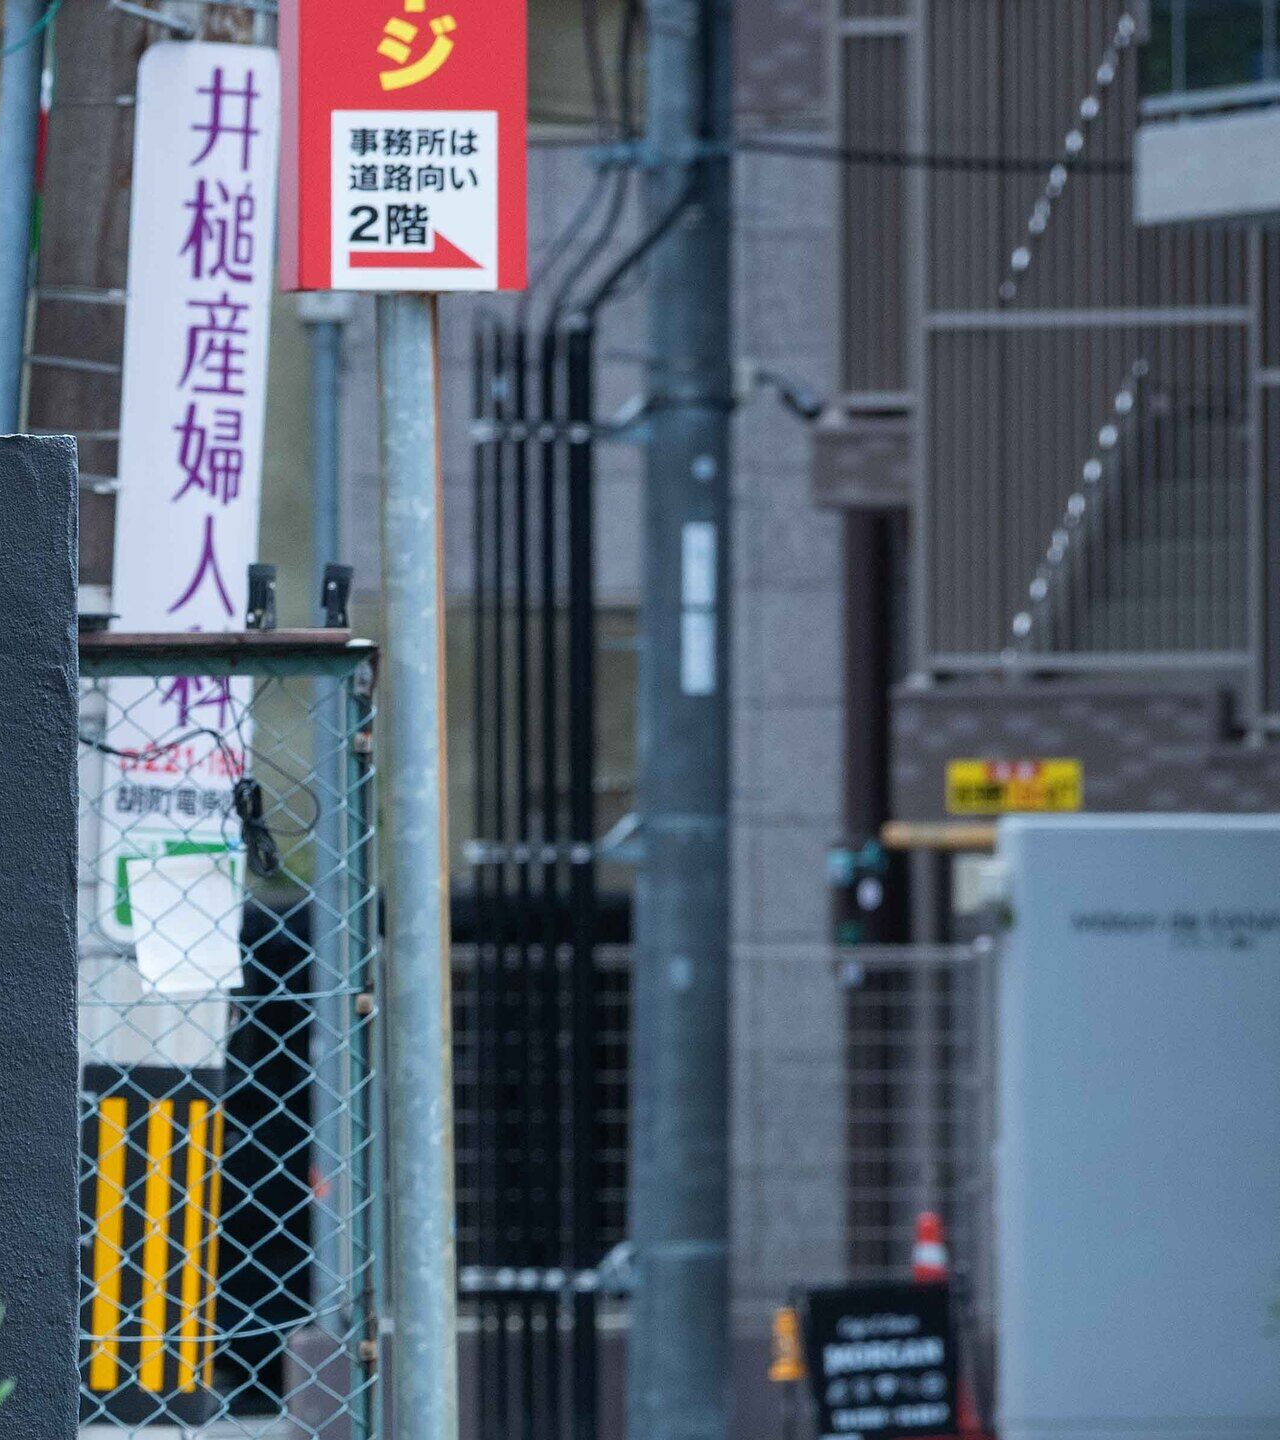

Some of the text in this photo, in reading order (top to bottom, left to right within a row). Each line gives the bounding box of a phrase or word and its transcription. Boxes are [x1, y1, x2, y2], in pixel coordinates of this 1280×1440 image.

[349, 127, 479, 157] 事務所は
[349, 164, 478, 193] 道路向い
[348, 203, 429, 245] 2階
